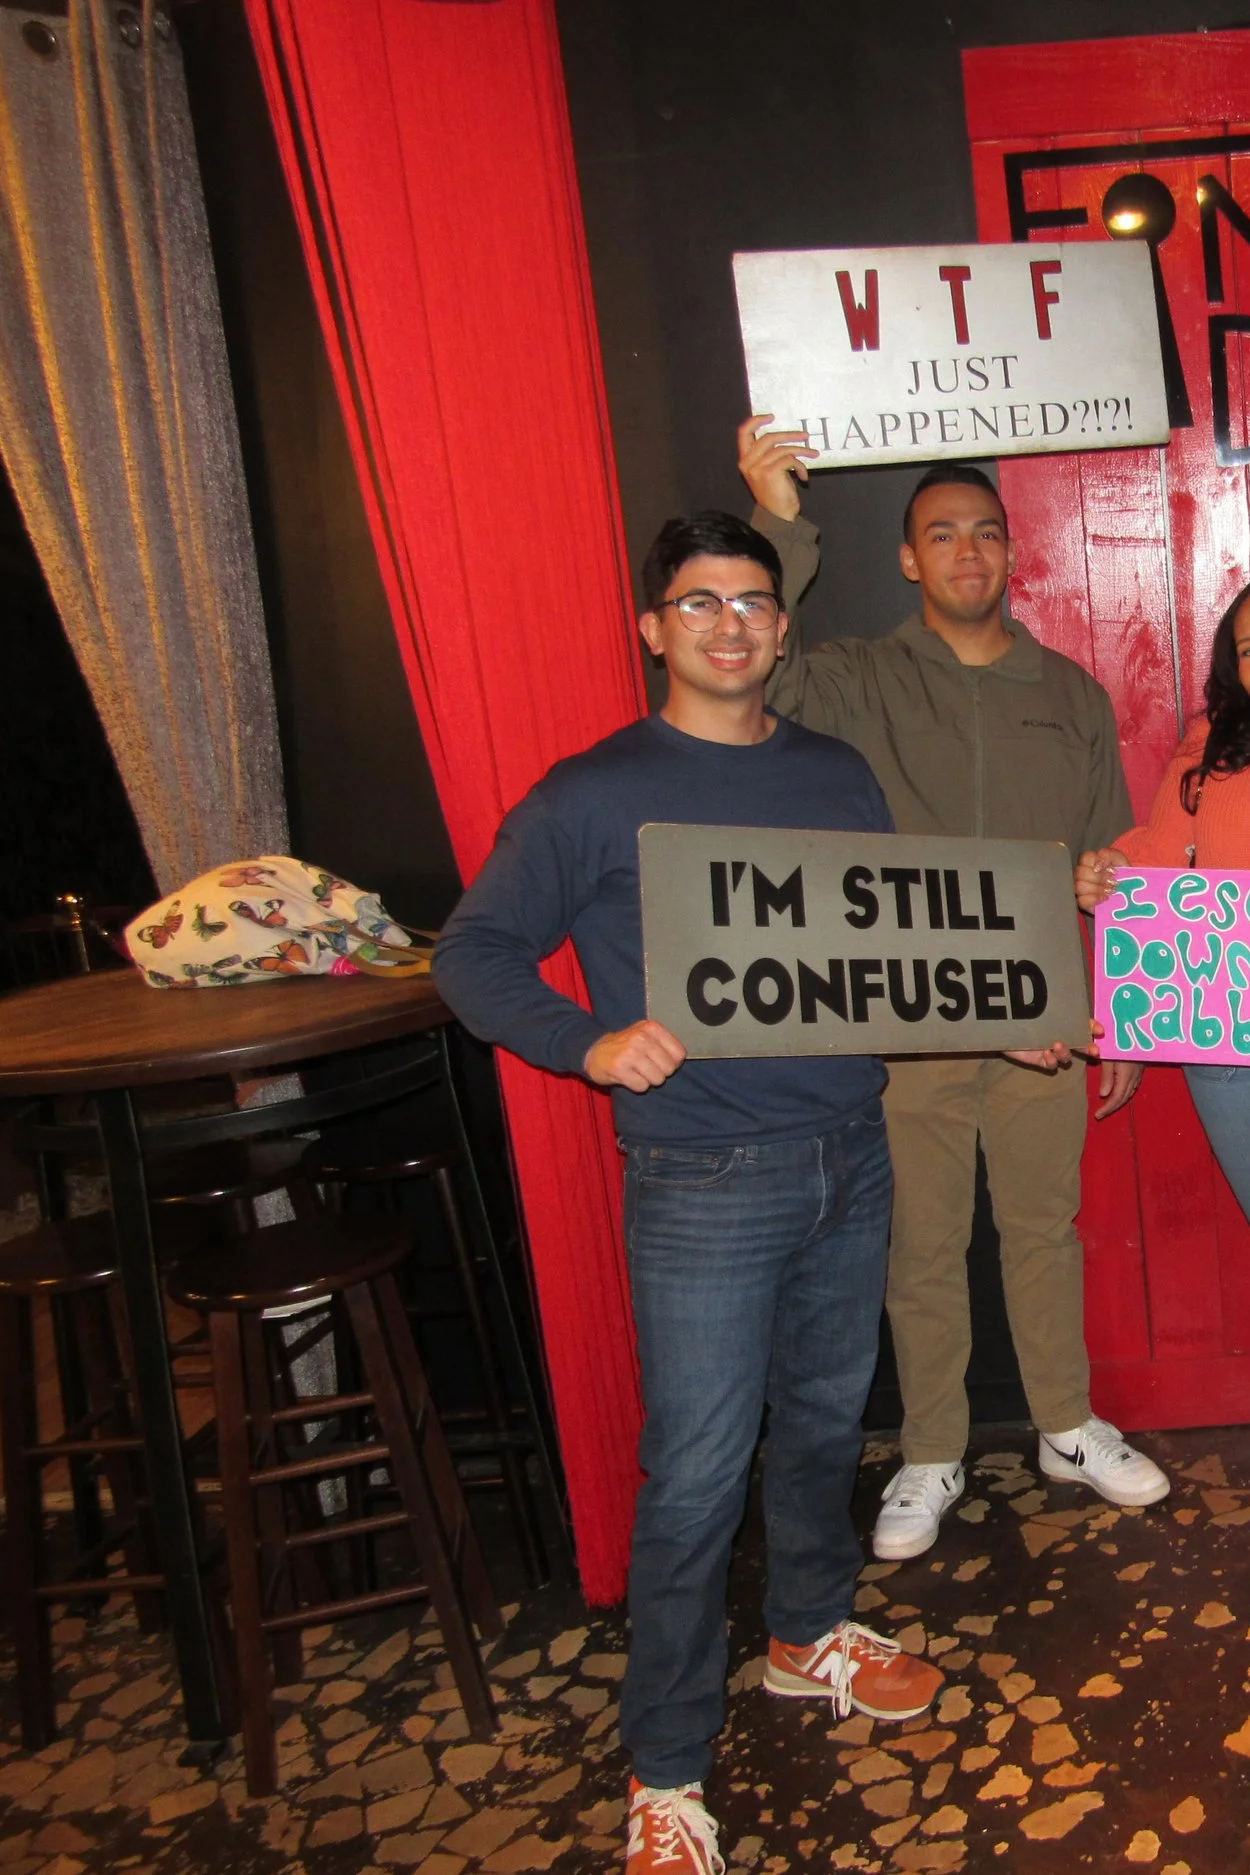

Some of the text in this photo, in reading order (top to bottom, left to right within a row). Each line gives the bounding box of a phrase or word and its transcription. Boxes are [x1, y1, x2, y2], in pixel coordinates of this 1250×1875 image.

[906, 355, 1018, 395] JUST
[797, 397, 1134, 453] HAPPENED?!?!
[709, 861, 1015, 930] I'M STILL
[1112, 876, 1158, 920] I
[686, 957, 1048, 1027] CONFUSED
